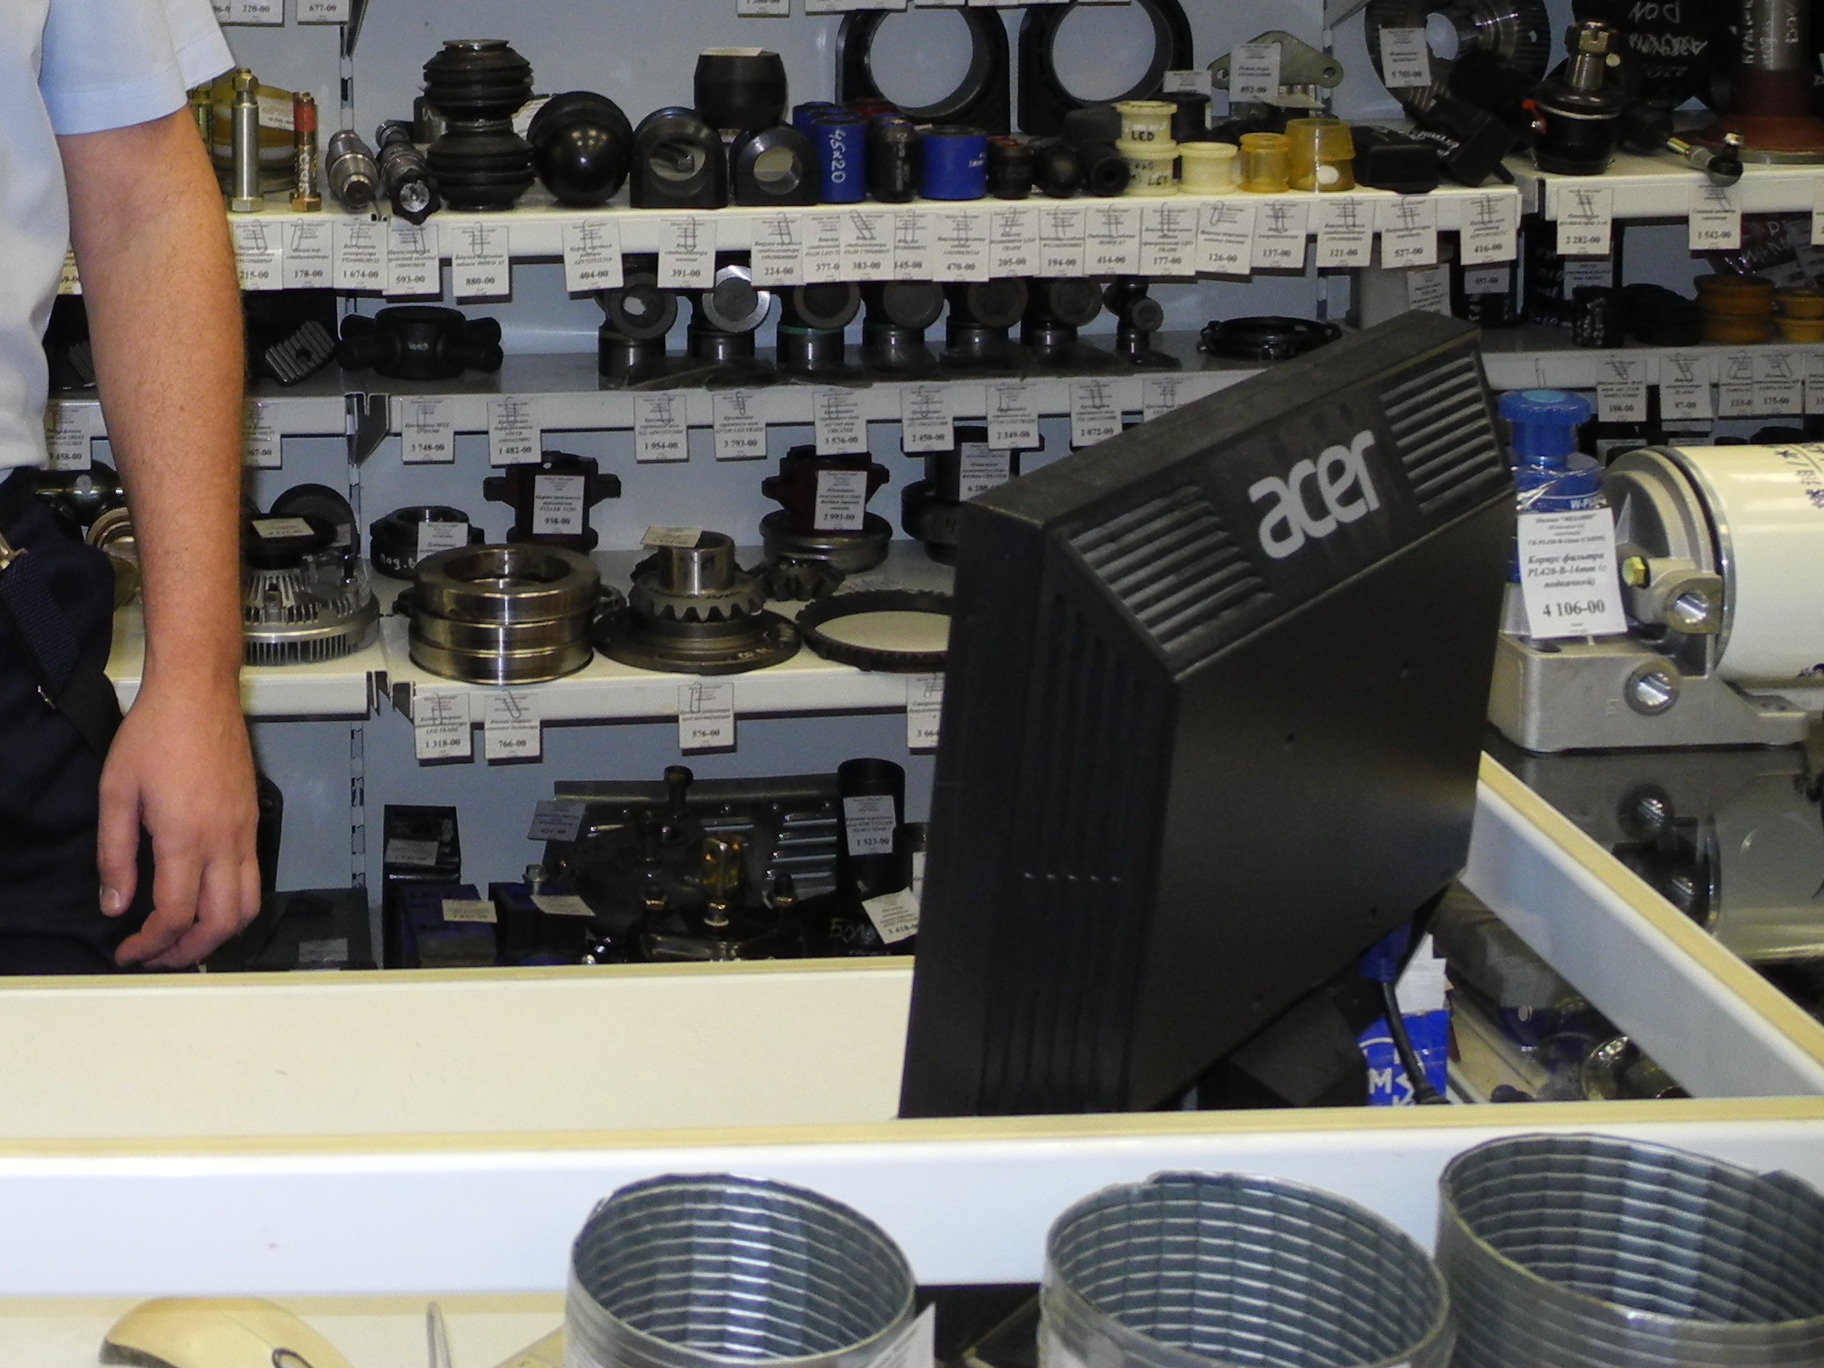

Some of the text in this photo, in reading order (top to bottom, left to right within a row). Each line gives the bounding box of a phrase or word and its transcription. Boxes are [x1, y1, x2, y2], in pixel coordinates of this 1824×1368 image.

[1248, 429, 1380, 559] acer
[1527, 554, 1561, 566] Корпус
[1556, 599, 1606, 617] 106-00
